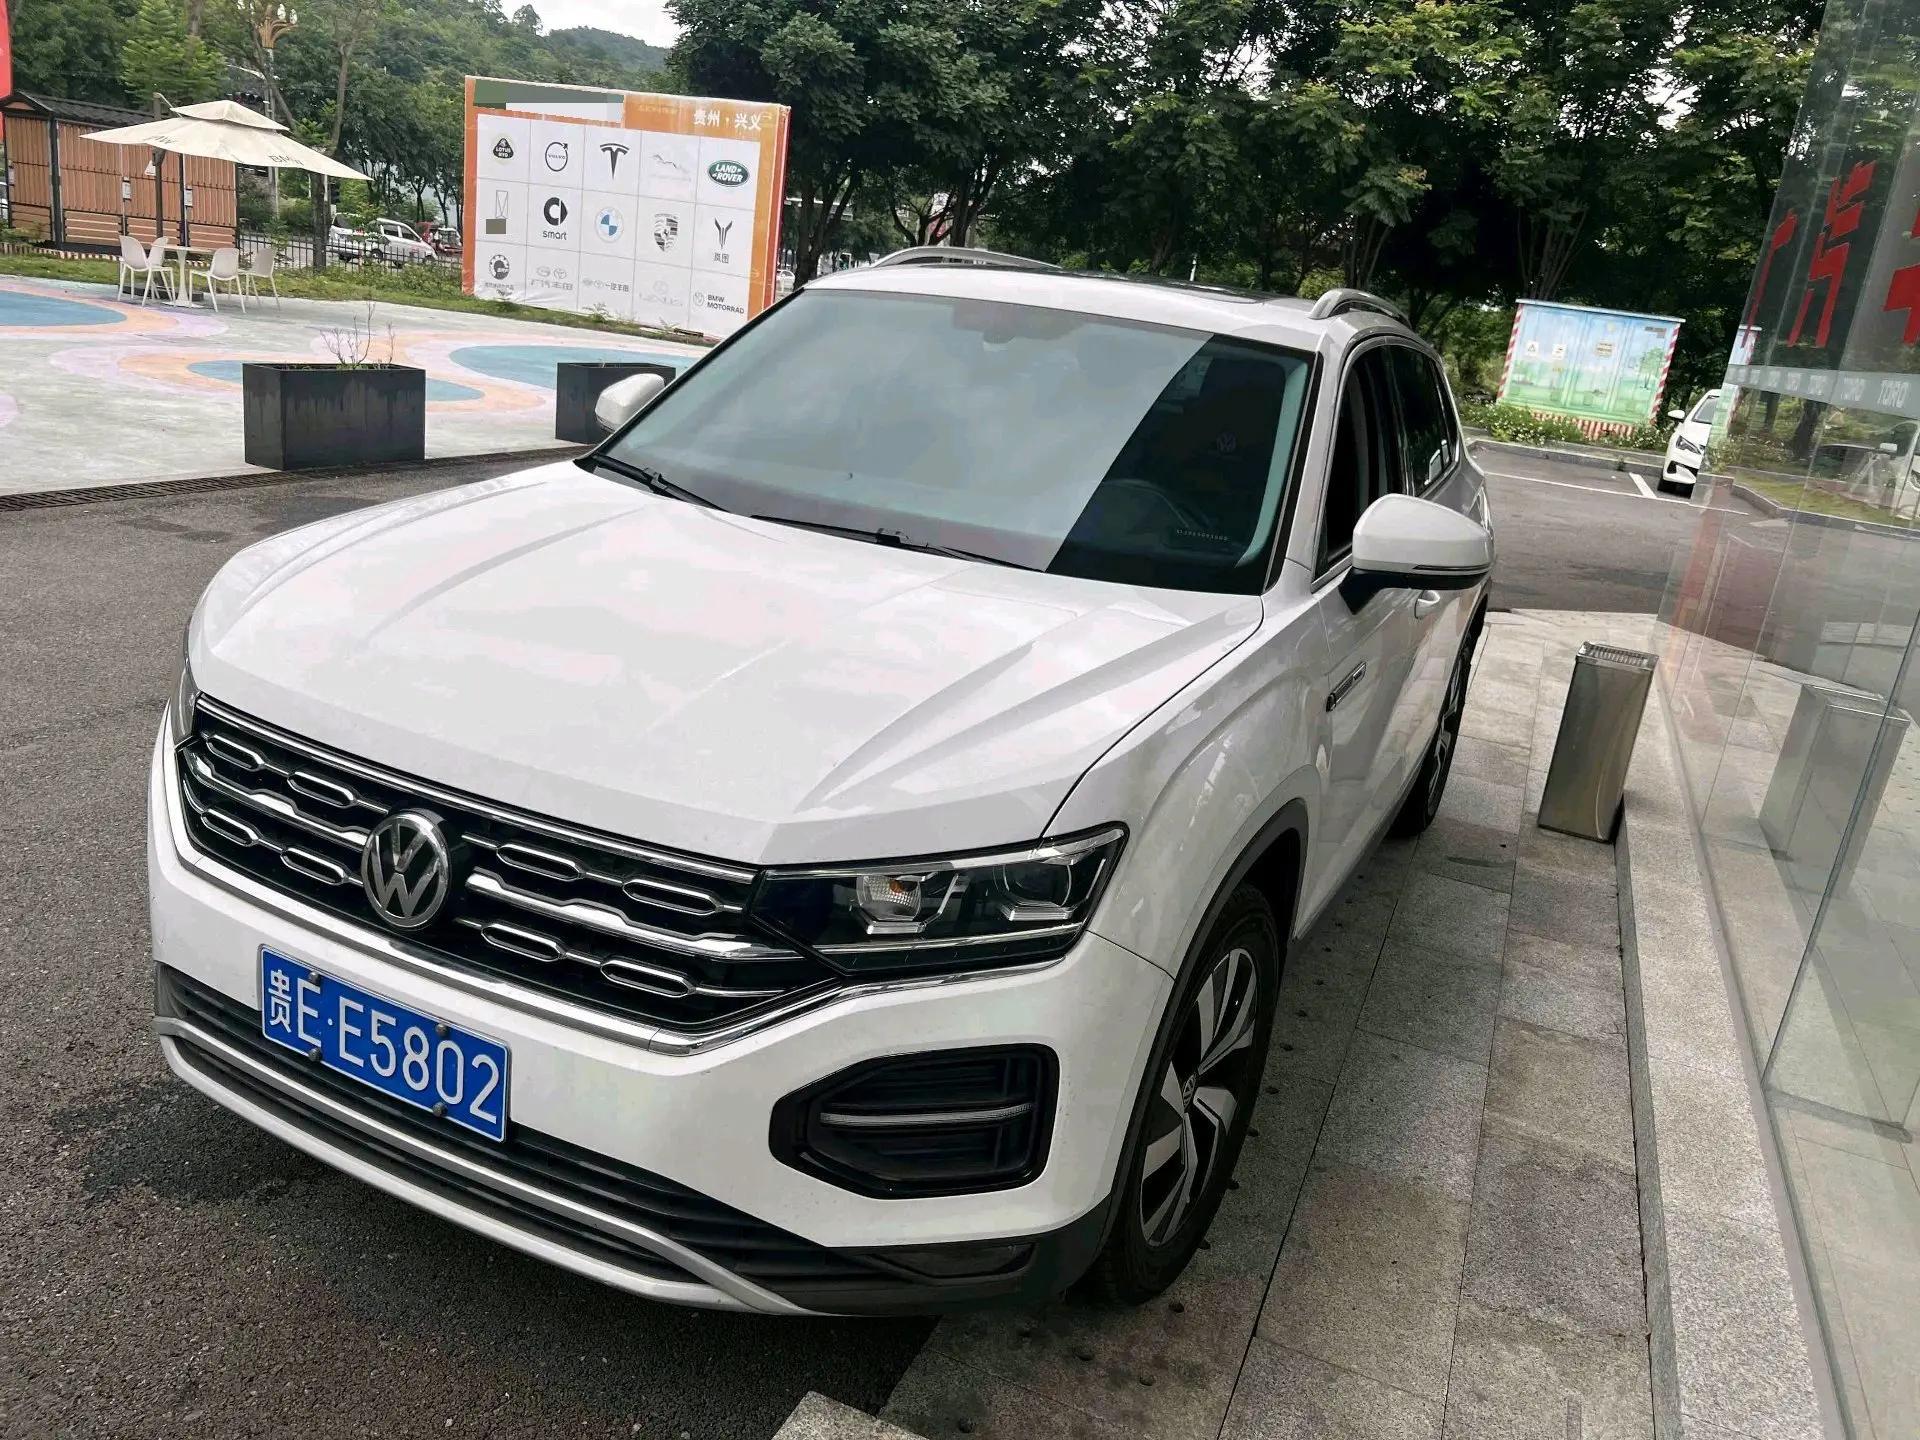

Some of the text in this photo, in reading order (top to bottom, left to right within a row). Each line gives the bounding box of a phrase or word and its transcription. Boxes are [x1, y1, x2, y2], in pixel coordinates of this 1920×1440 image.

[715, 163, 738, 173] LAND
[715, 172, 744, 183] ROVER
[542, 230, 567, 241] smart
[707, 293, 726, 304] BMW
[707, 302, 745, 314] MOTORRAD
